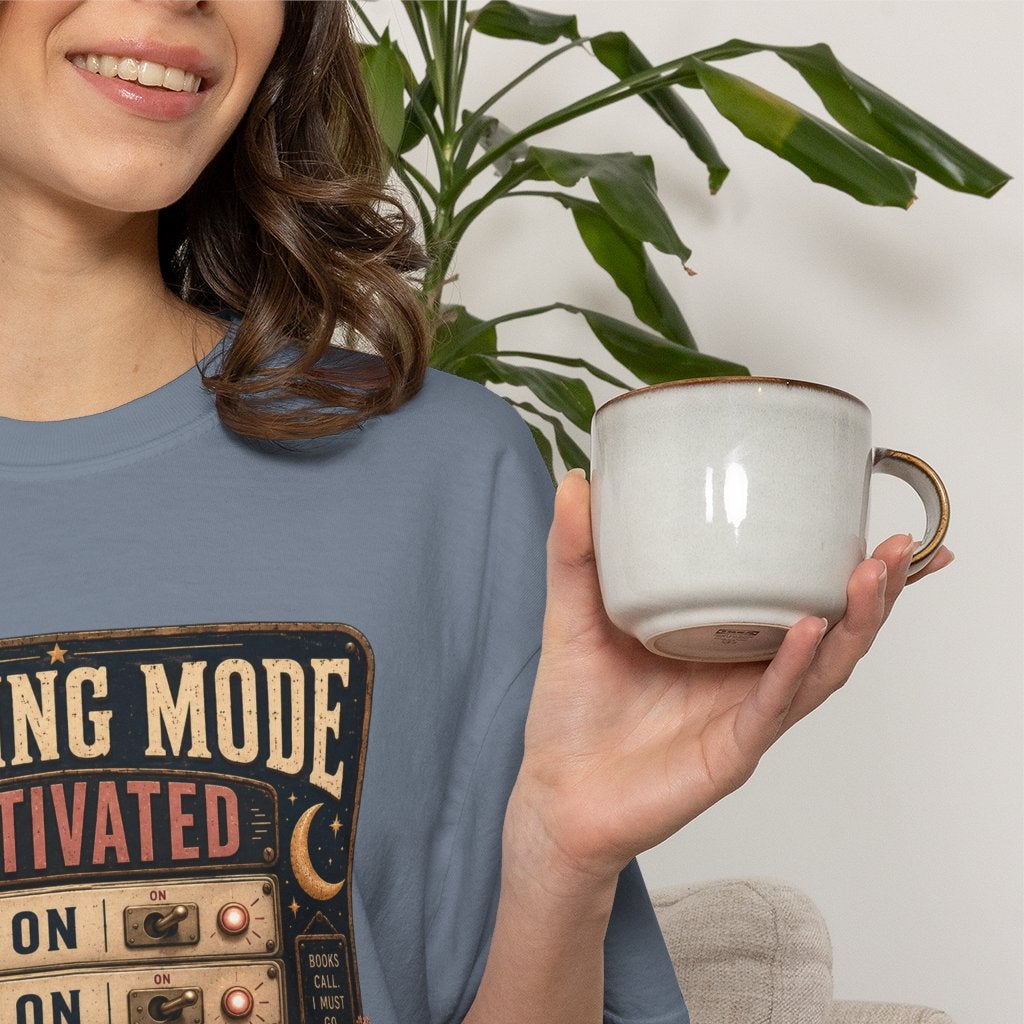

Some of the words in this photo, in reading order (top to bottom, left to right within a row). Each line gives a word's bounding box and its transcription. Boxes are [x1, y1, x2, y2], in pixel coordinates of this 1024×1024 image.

[139, 657, 351, 801] MODE
[149, 889, 167, 902] ON
[11, 906, 77, 955] ON
[308, 953, 340, 968] BOOKS
[153, 973, 171, 986] ON
[313, 974, 341, 989] CALL.
[312, 995, 317, 1010] I
[320, 995, 345, 1010] MUST
